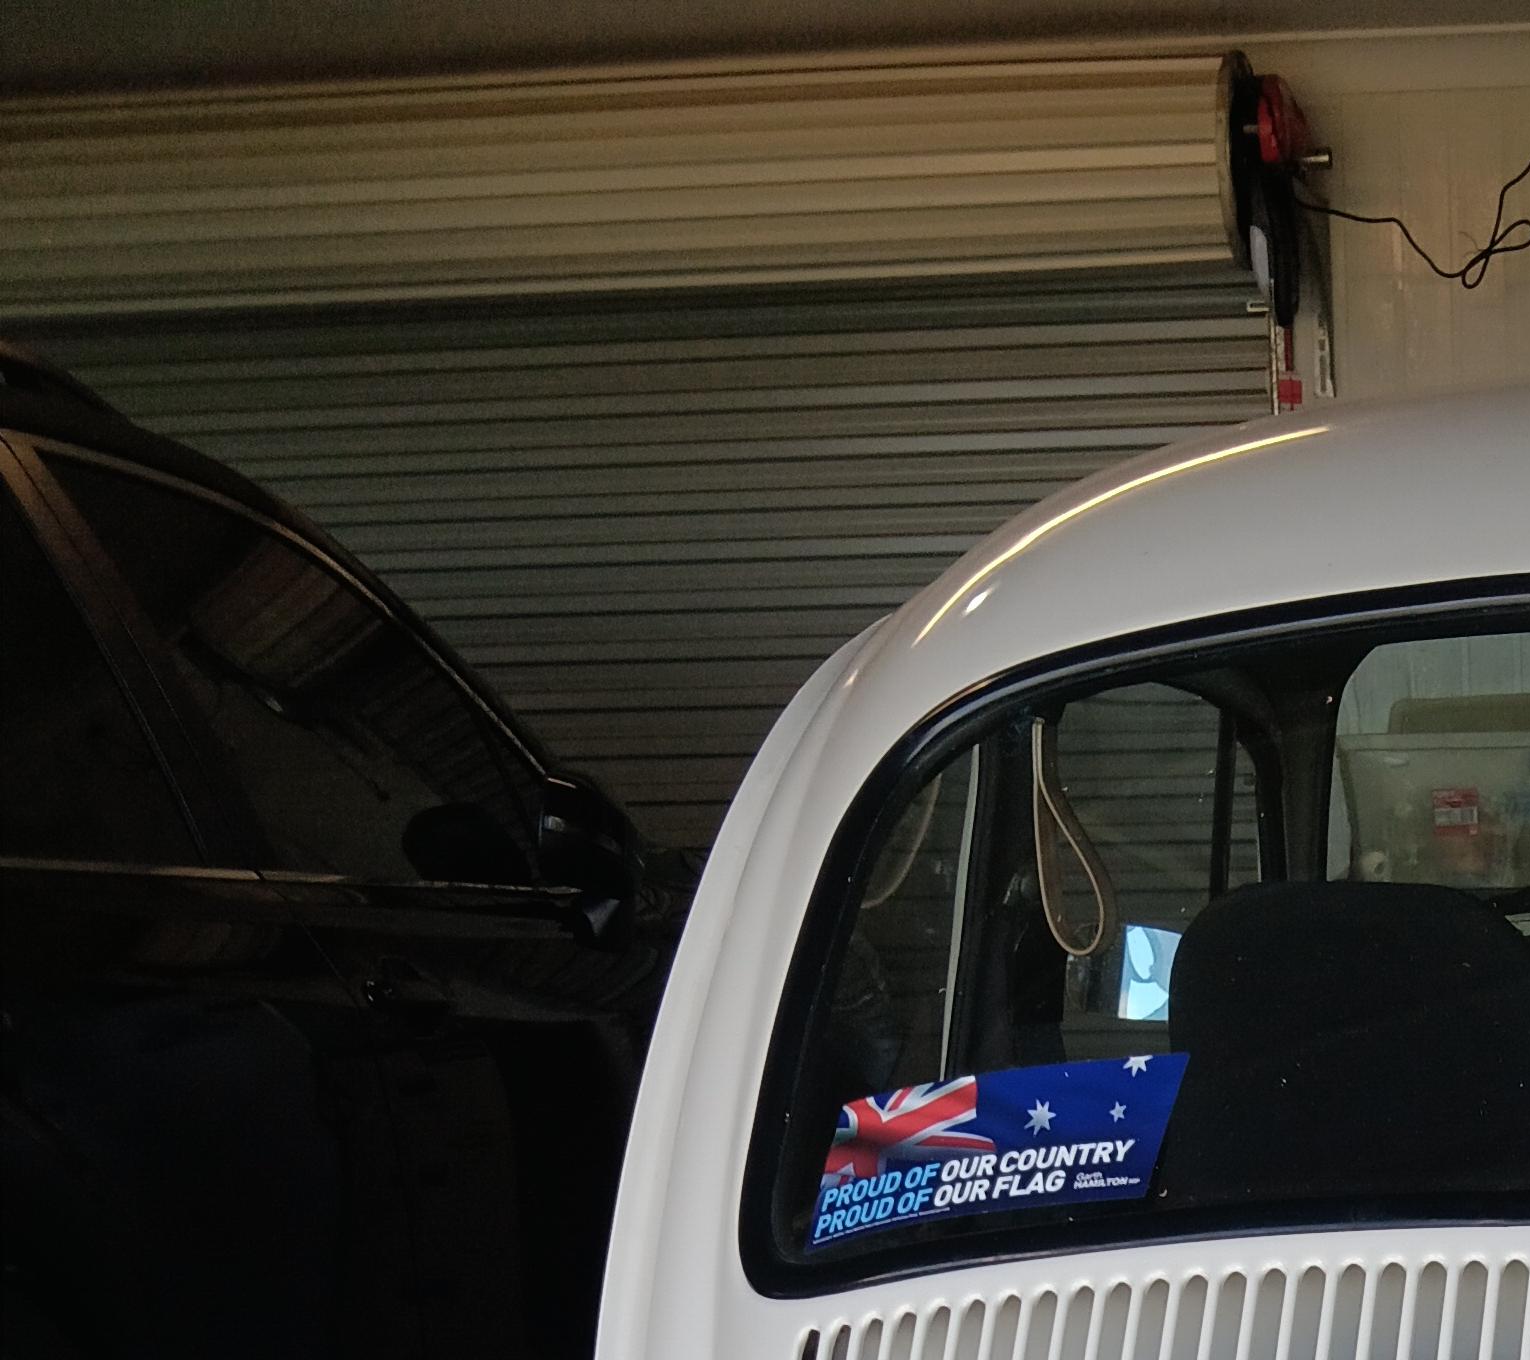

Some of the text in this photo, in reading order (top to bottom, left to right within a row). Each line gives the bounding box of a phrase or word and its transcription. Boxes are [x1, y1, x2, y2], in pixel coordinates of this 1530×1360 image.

[814, 1169, 1066, 1238] PROUD OF OUR FLAG
[821, 1139, 1136, 1212] PROUD OF OUR COUNTRY
